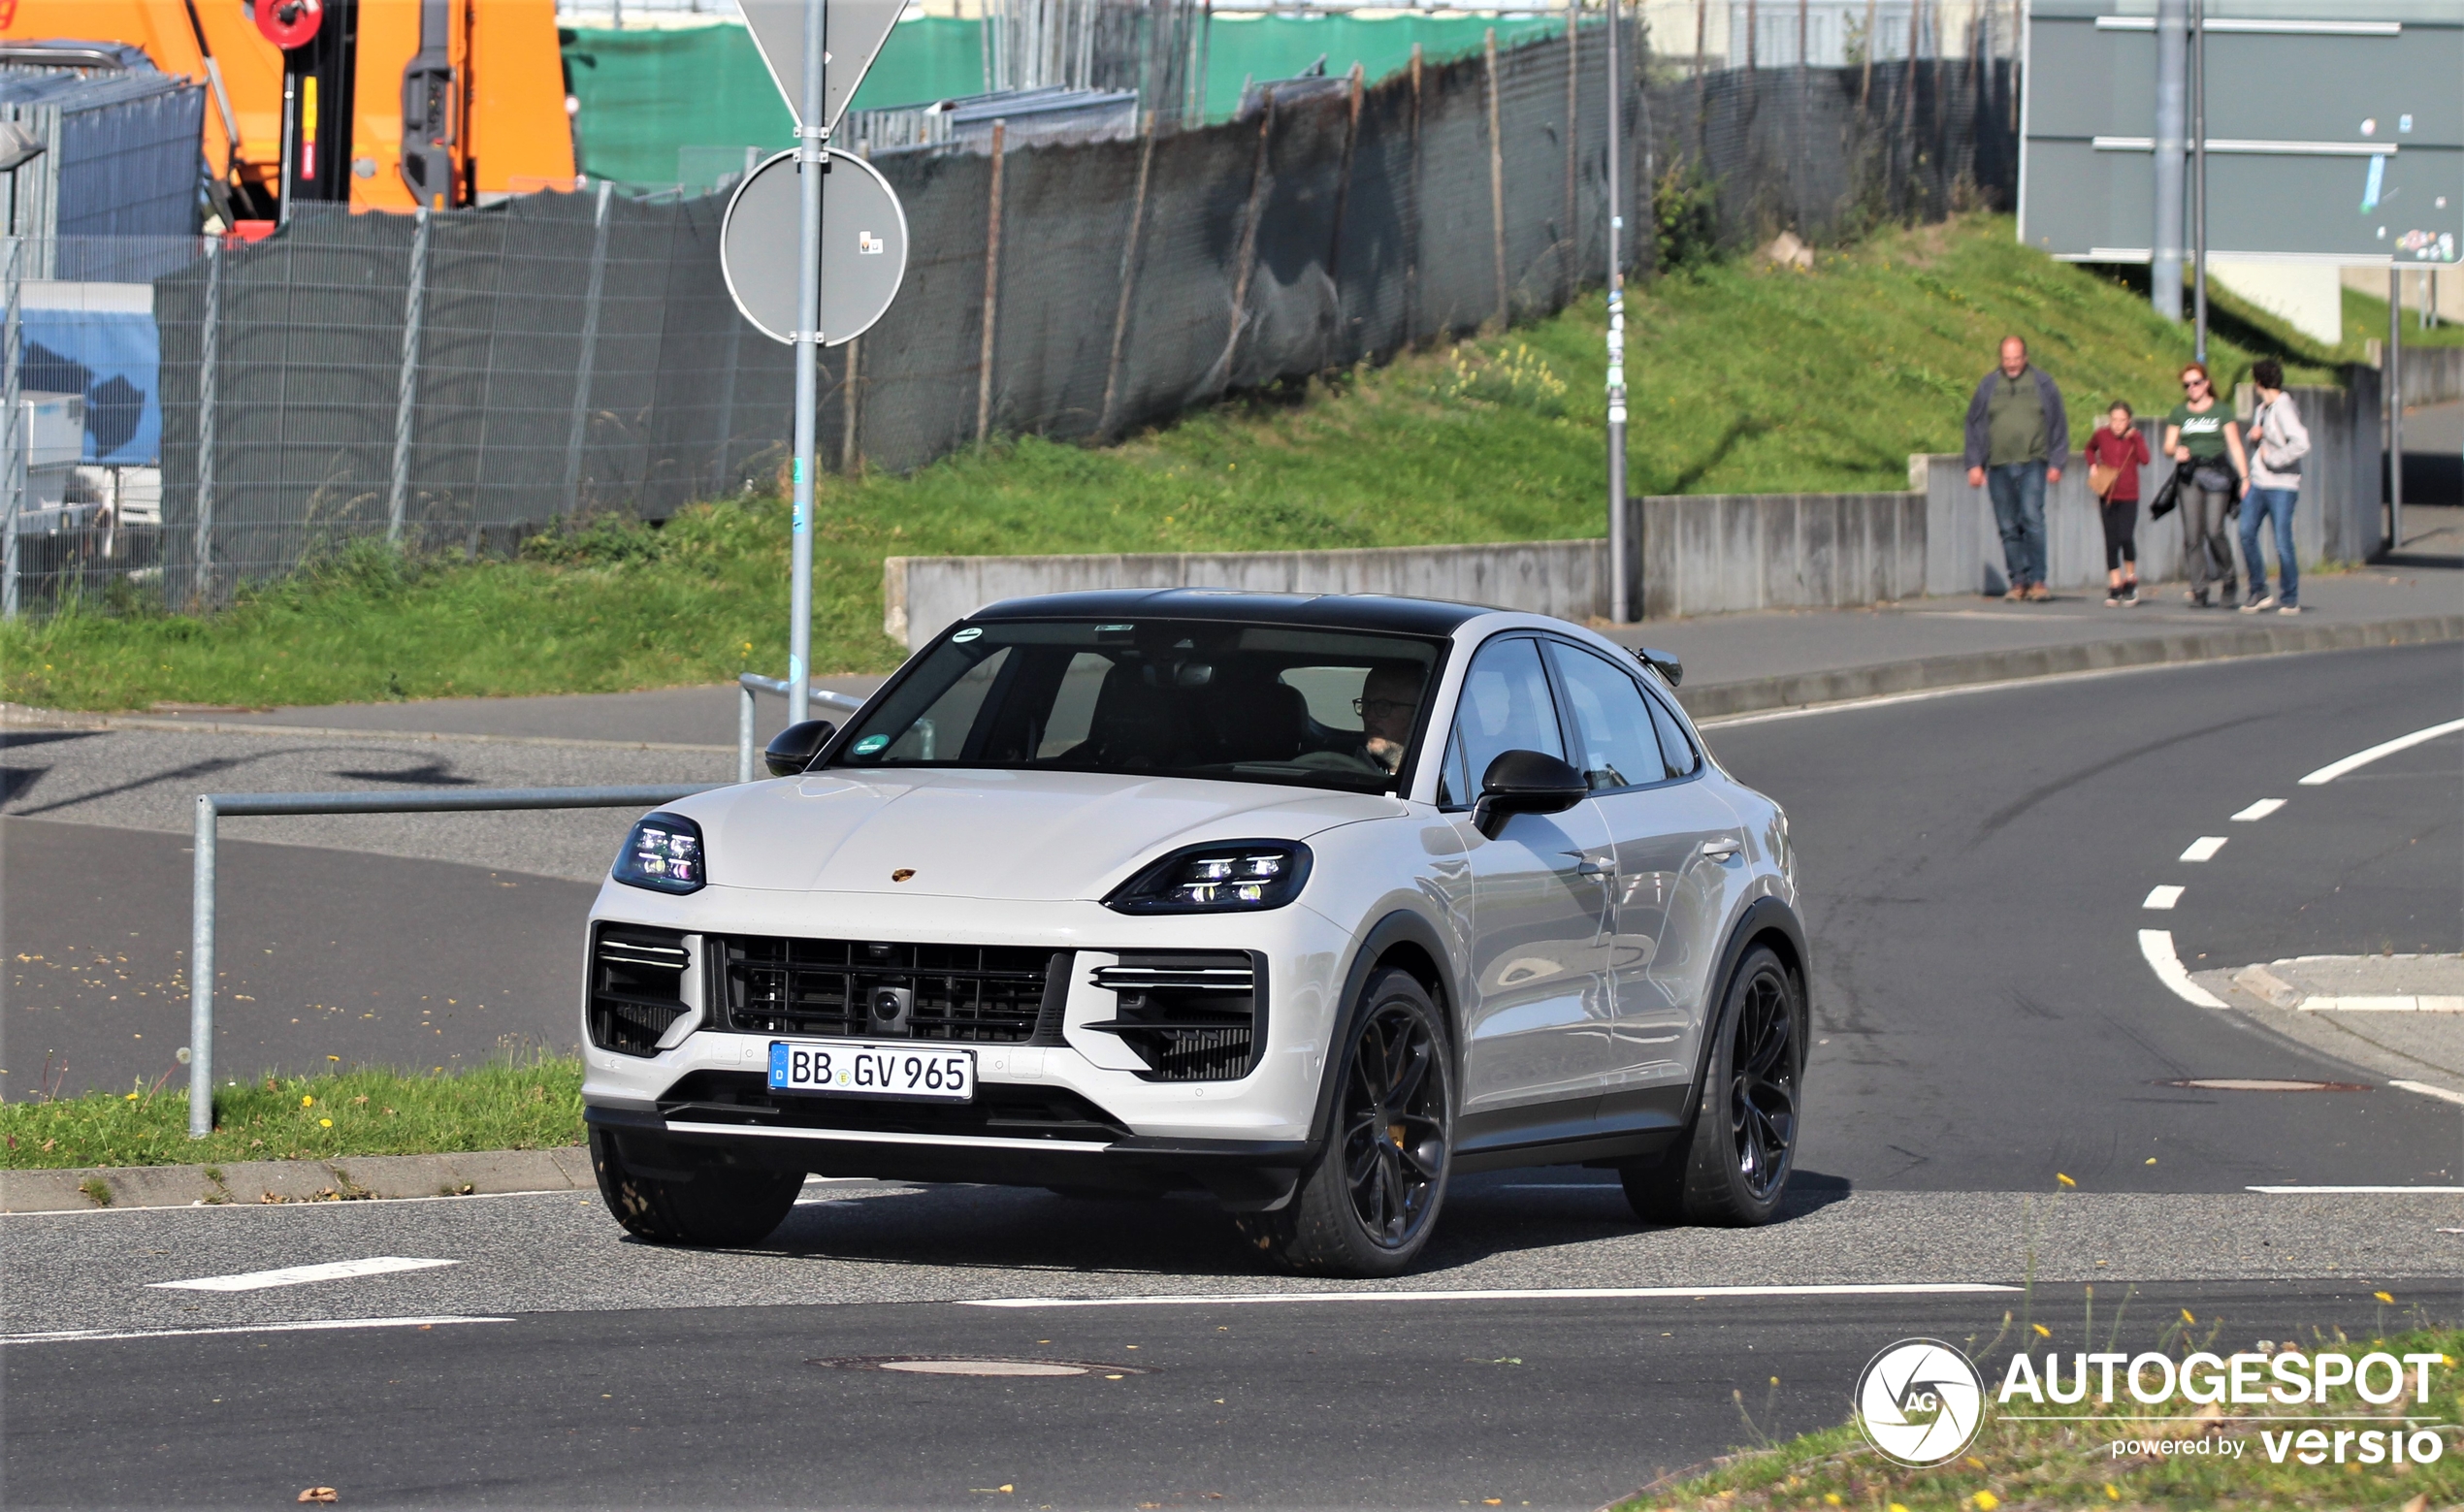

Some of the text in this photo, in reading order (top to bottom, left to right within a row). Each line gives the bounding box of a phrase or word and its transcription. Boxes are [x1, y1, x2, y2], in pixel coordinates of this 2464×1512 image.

[775, 1069, 784, 1080] D
[793, 1051, 964, 1090] BB GV 965
